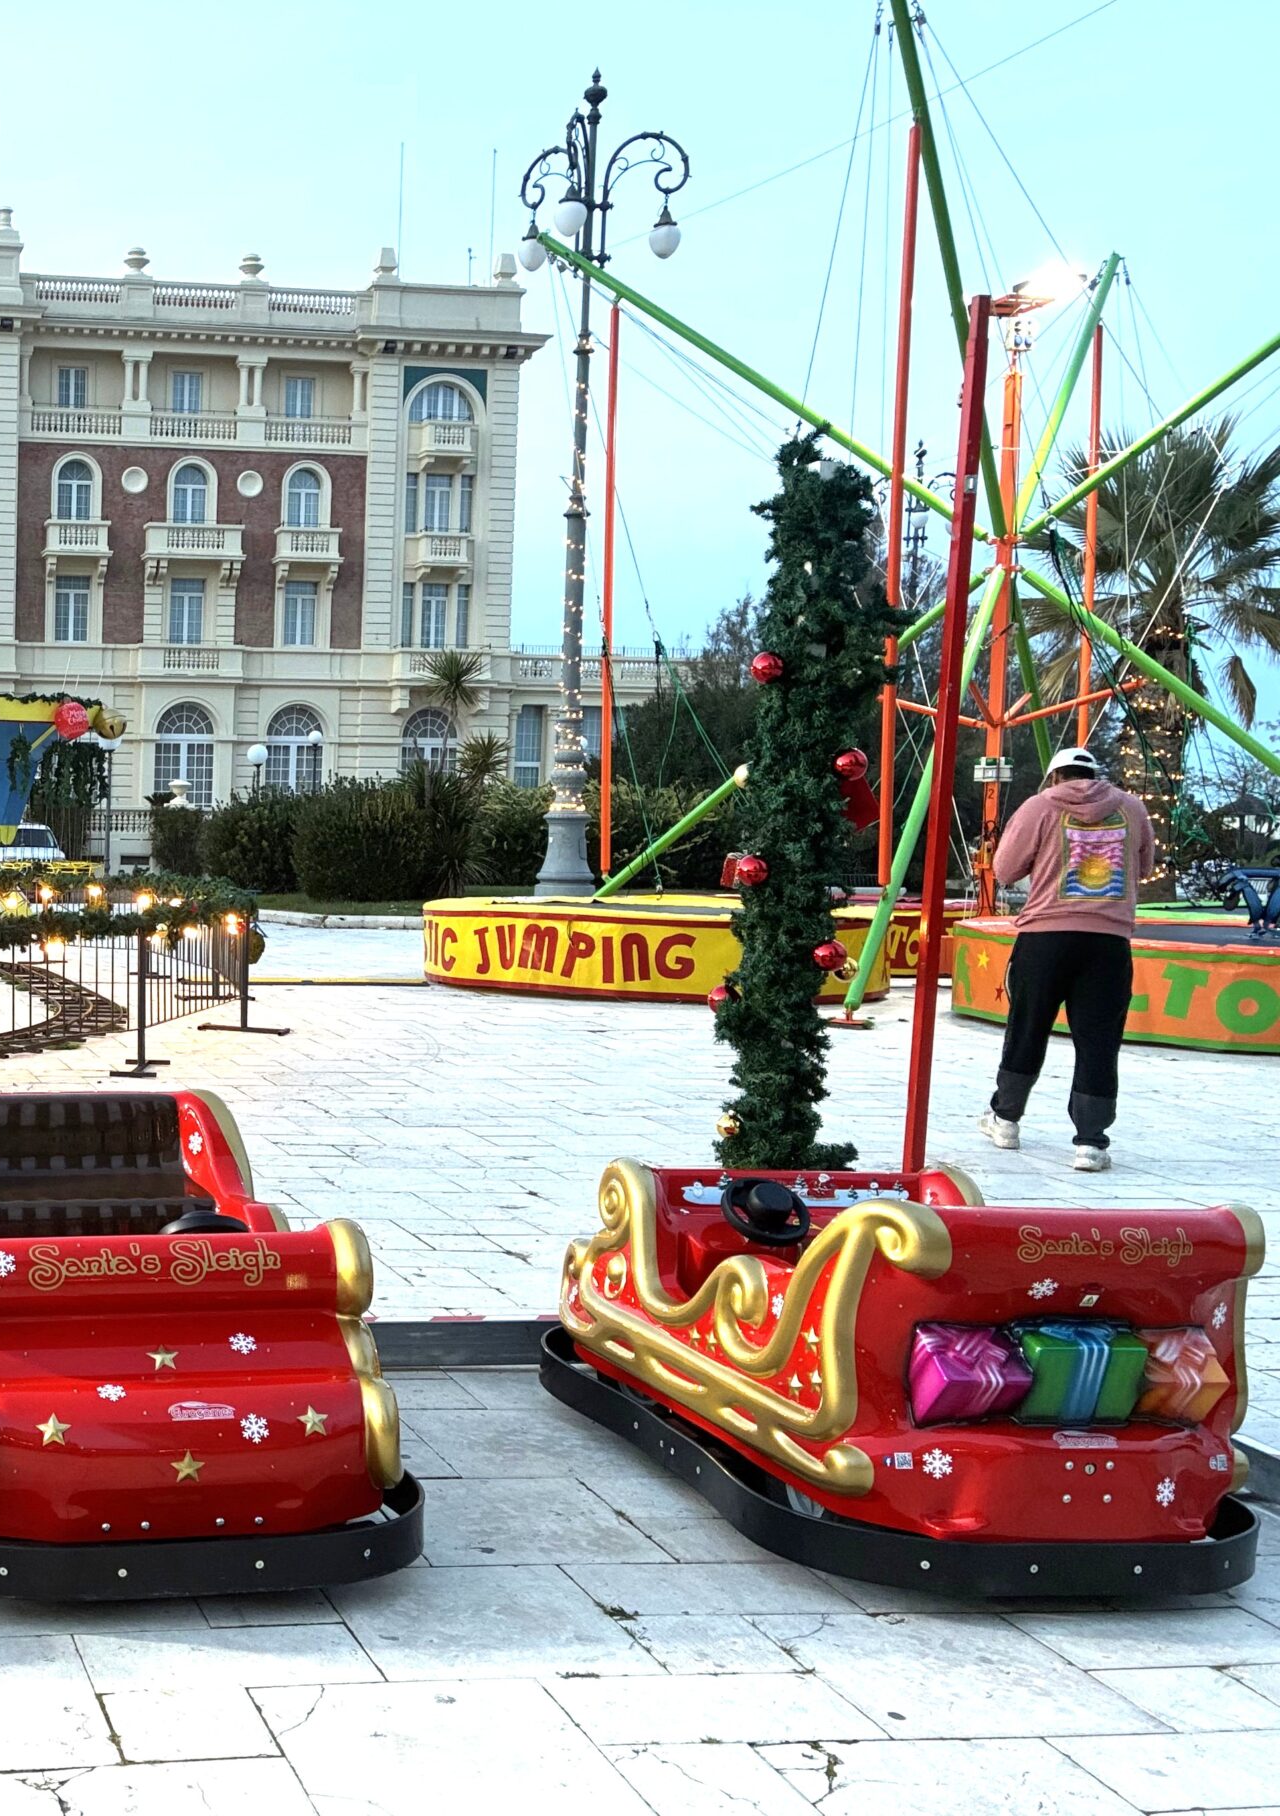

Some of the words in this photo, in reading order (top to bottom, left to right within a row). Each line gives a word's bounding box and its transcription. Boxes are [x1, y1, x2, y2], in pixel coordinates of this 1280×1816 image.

[988, 788, 995, 800] 2
[474, 923, 698, 984] JUMPING
[28, 1243, 161, 1292] Santa's
[169, 1238, 281, 1287] Sleigh
[1017, 1225, 1114, 1263] Santa's
[1120, 1227, 1193, 1267] Sleigh
